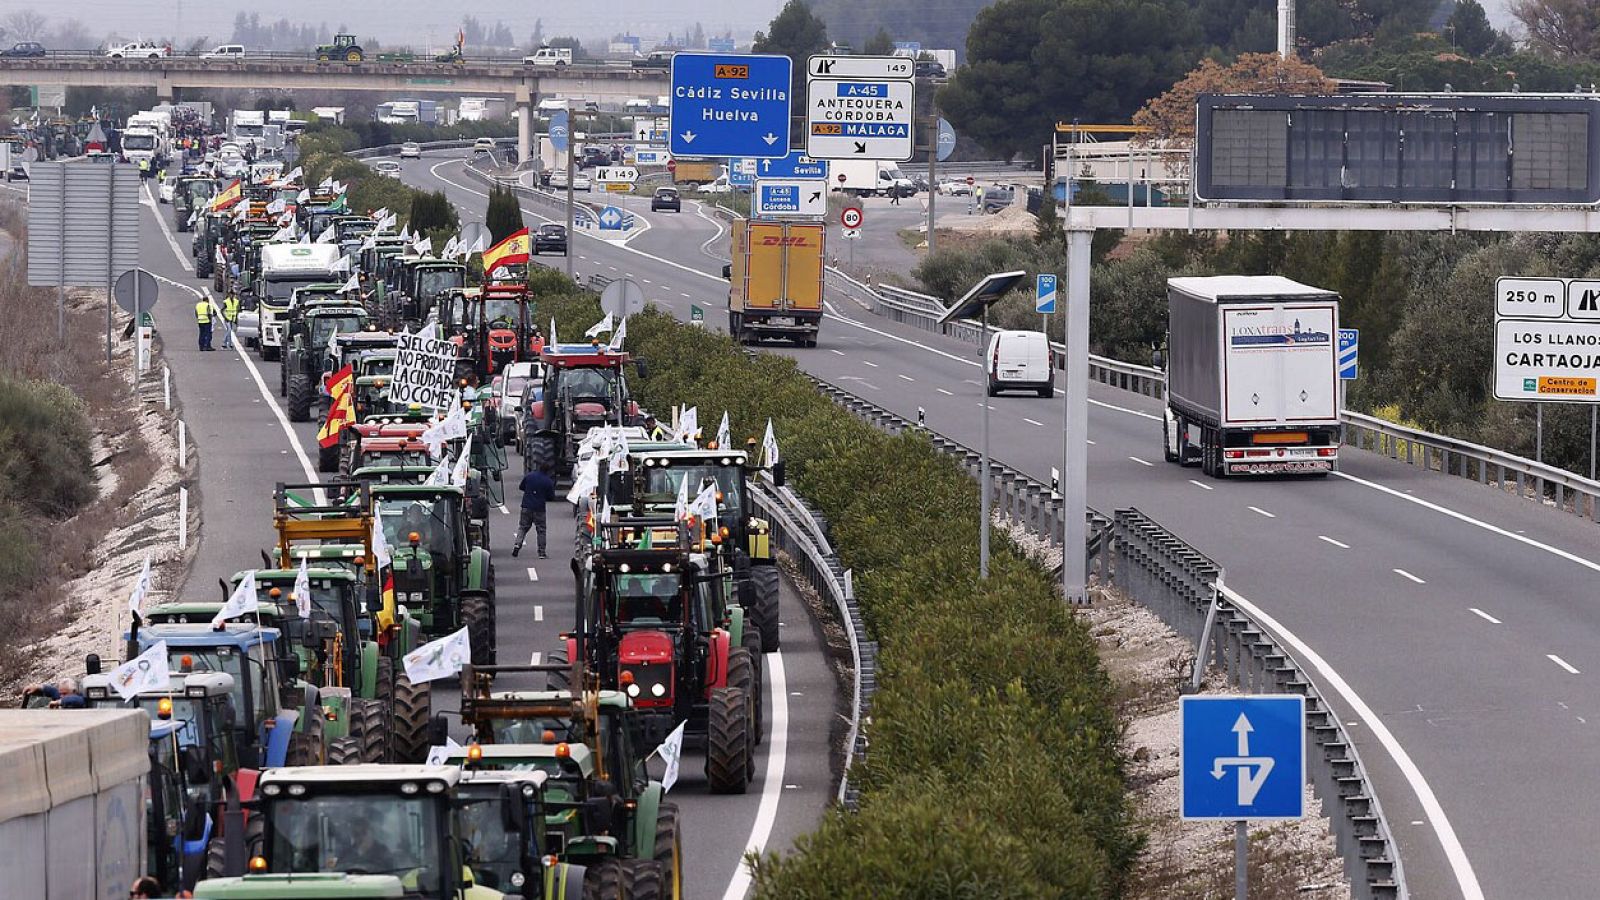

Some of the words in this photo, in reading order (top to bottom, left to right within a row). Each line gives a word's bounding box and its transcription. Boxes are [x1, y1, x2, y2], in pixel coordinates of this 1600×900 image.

[717, 67, 746, 77] A-92
[887, 64, 907, 72] 149
[676, 86, 722, 99] Cádiz
[730, 87, 786, 101] Sevilla
[848, 85, 878, 96] A-45
[817, 98, 904, 109] ANTEQUERA
[702, 107, 759, 121] Huelva
[813, 125, 841, 134] A-92
[846, 123, 905, 135] MÁLAGA
[615, 170, 634, 178] 149
[794, 166, 822, 175] Sevilla
[846, 214, 858, 222] 80
[762, 236, 808, 247] DHL
[1506, 291, 1537, 303] 250
[1543, 294, 1556, 303] m
[1513, 333, 1543, 344] LOS
[1548, 334, 1600, 346] LLANO
[397, 351, 413, 366] NO
[393, 365, 408, 384] LA
[1547, 378, 1575, 386] Centro
[391, 382, 411, 401] NO
